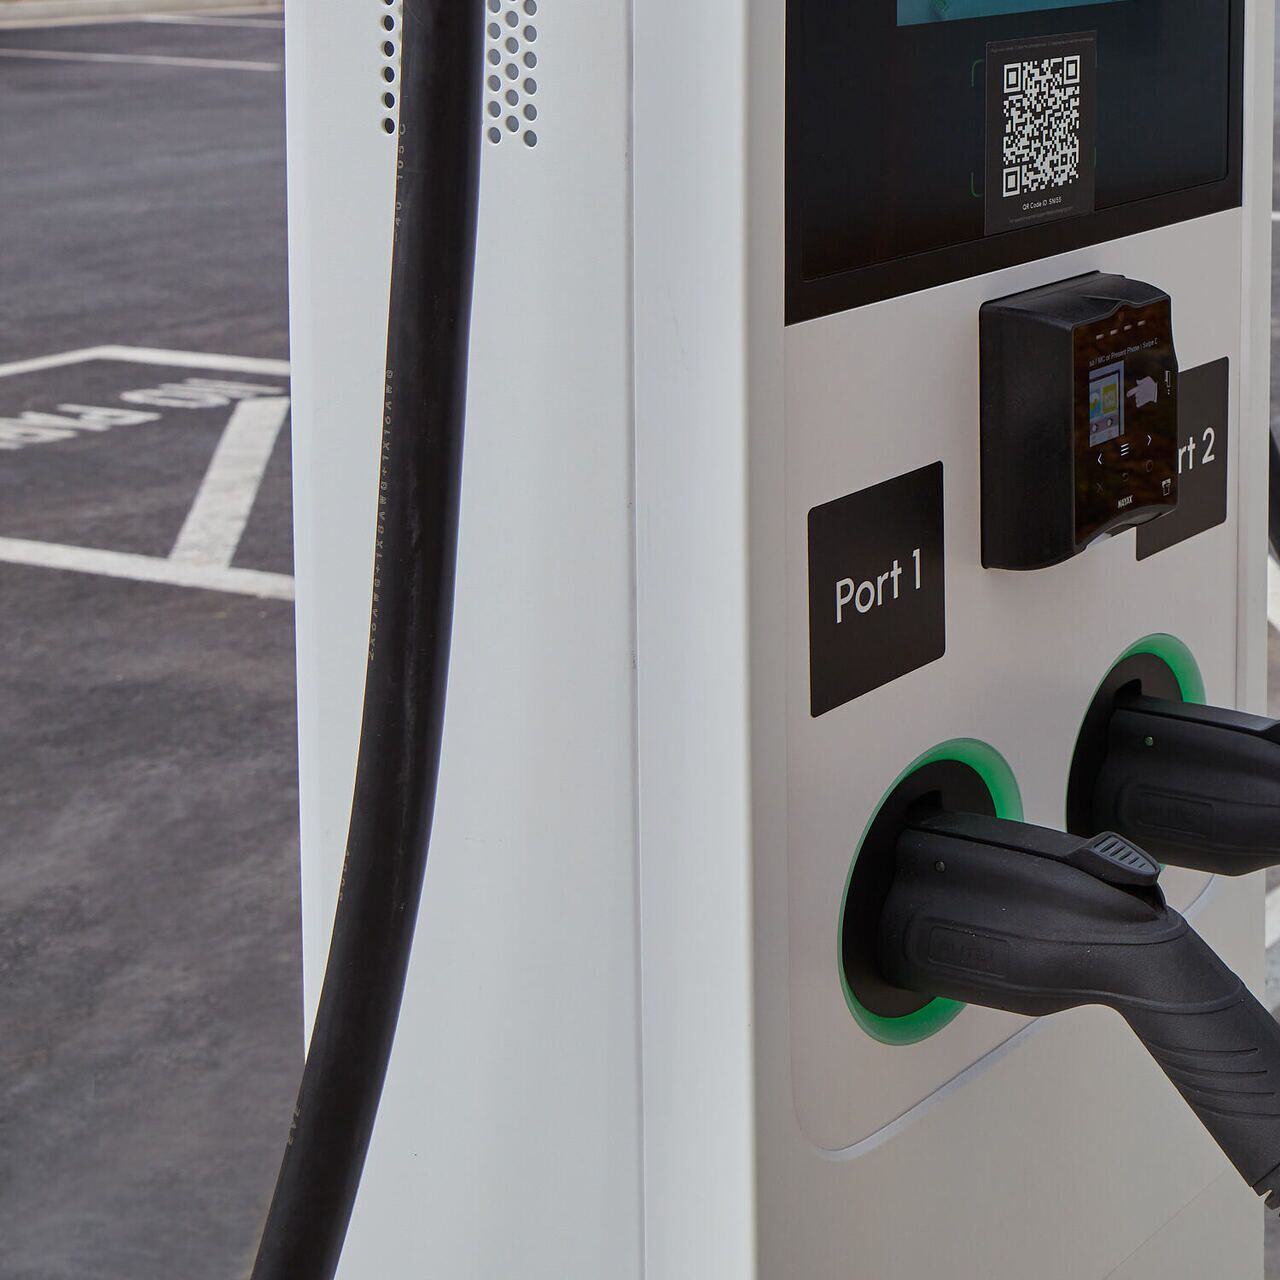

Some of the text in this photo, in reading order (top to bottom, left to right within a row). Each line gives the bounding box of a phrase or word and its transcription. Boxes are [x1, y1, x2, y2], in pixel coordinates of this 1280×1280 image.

[1178, 426, 1215, 474] rt 2
[836, 548, 921, 624] Port 1
